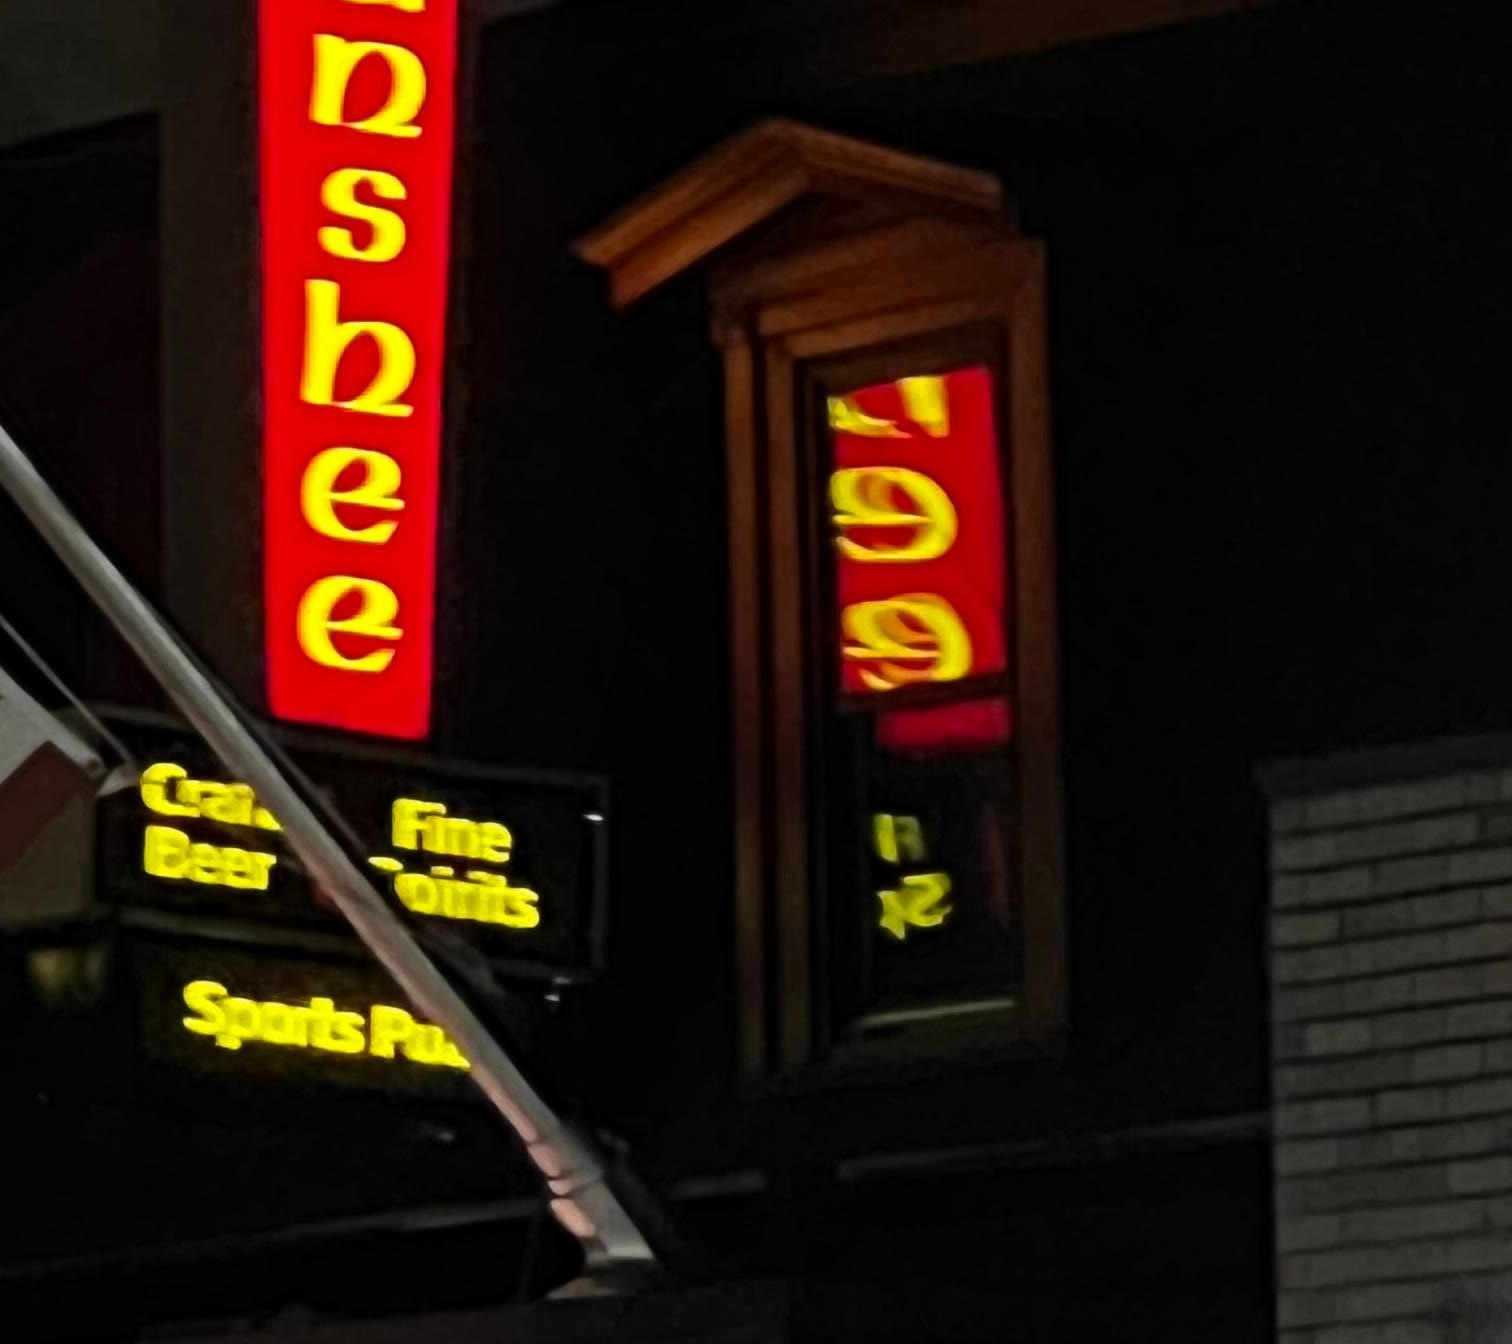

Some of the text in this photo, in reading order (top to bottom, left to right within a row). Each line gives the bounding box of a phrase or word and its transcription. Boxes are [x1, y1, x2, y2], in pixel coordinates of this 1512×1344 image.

[140, 762, 285, 832] Cra
[391, 797, 513, 863] Fine
[144, 825, 278, 891] Beer
[367, 855, 540, 929] pirits
[182, 980, 472, 1073] Sports Pu
